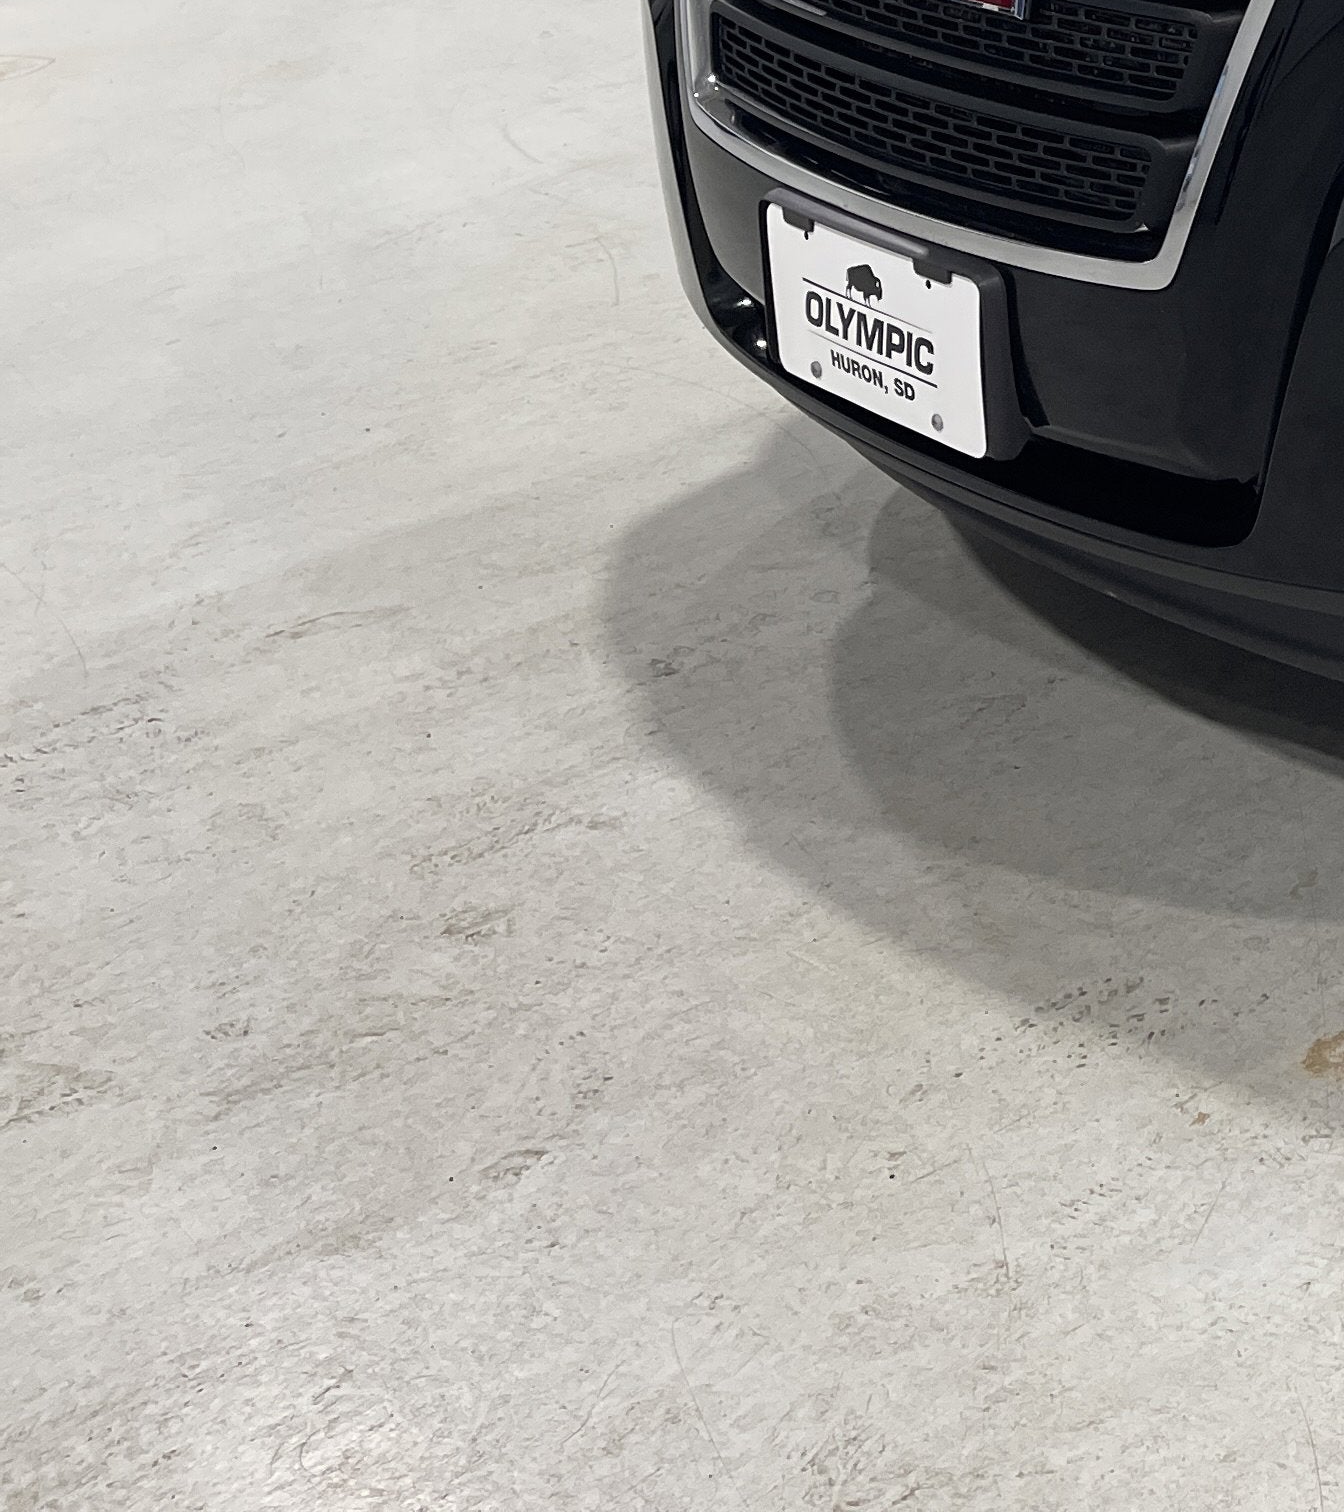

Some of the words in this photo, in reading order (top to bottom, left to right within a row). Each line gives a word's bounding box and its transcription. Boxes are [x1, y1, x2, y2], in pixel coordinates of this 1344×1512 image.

[805, 290, 935, 375] OLYMPIC
[830, 349, 889, 394] HURON,
[893, 377, 916, 401] SD
